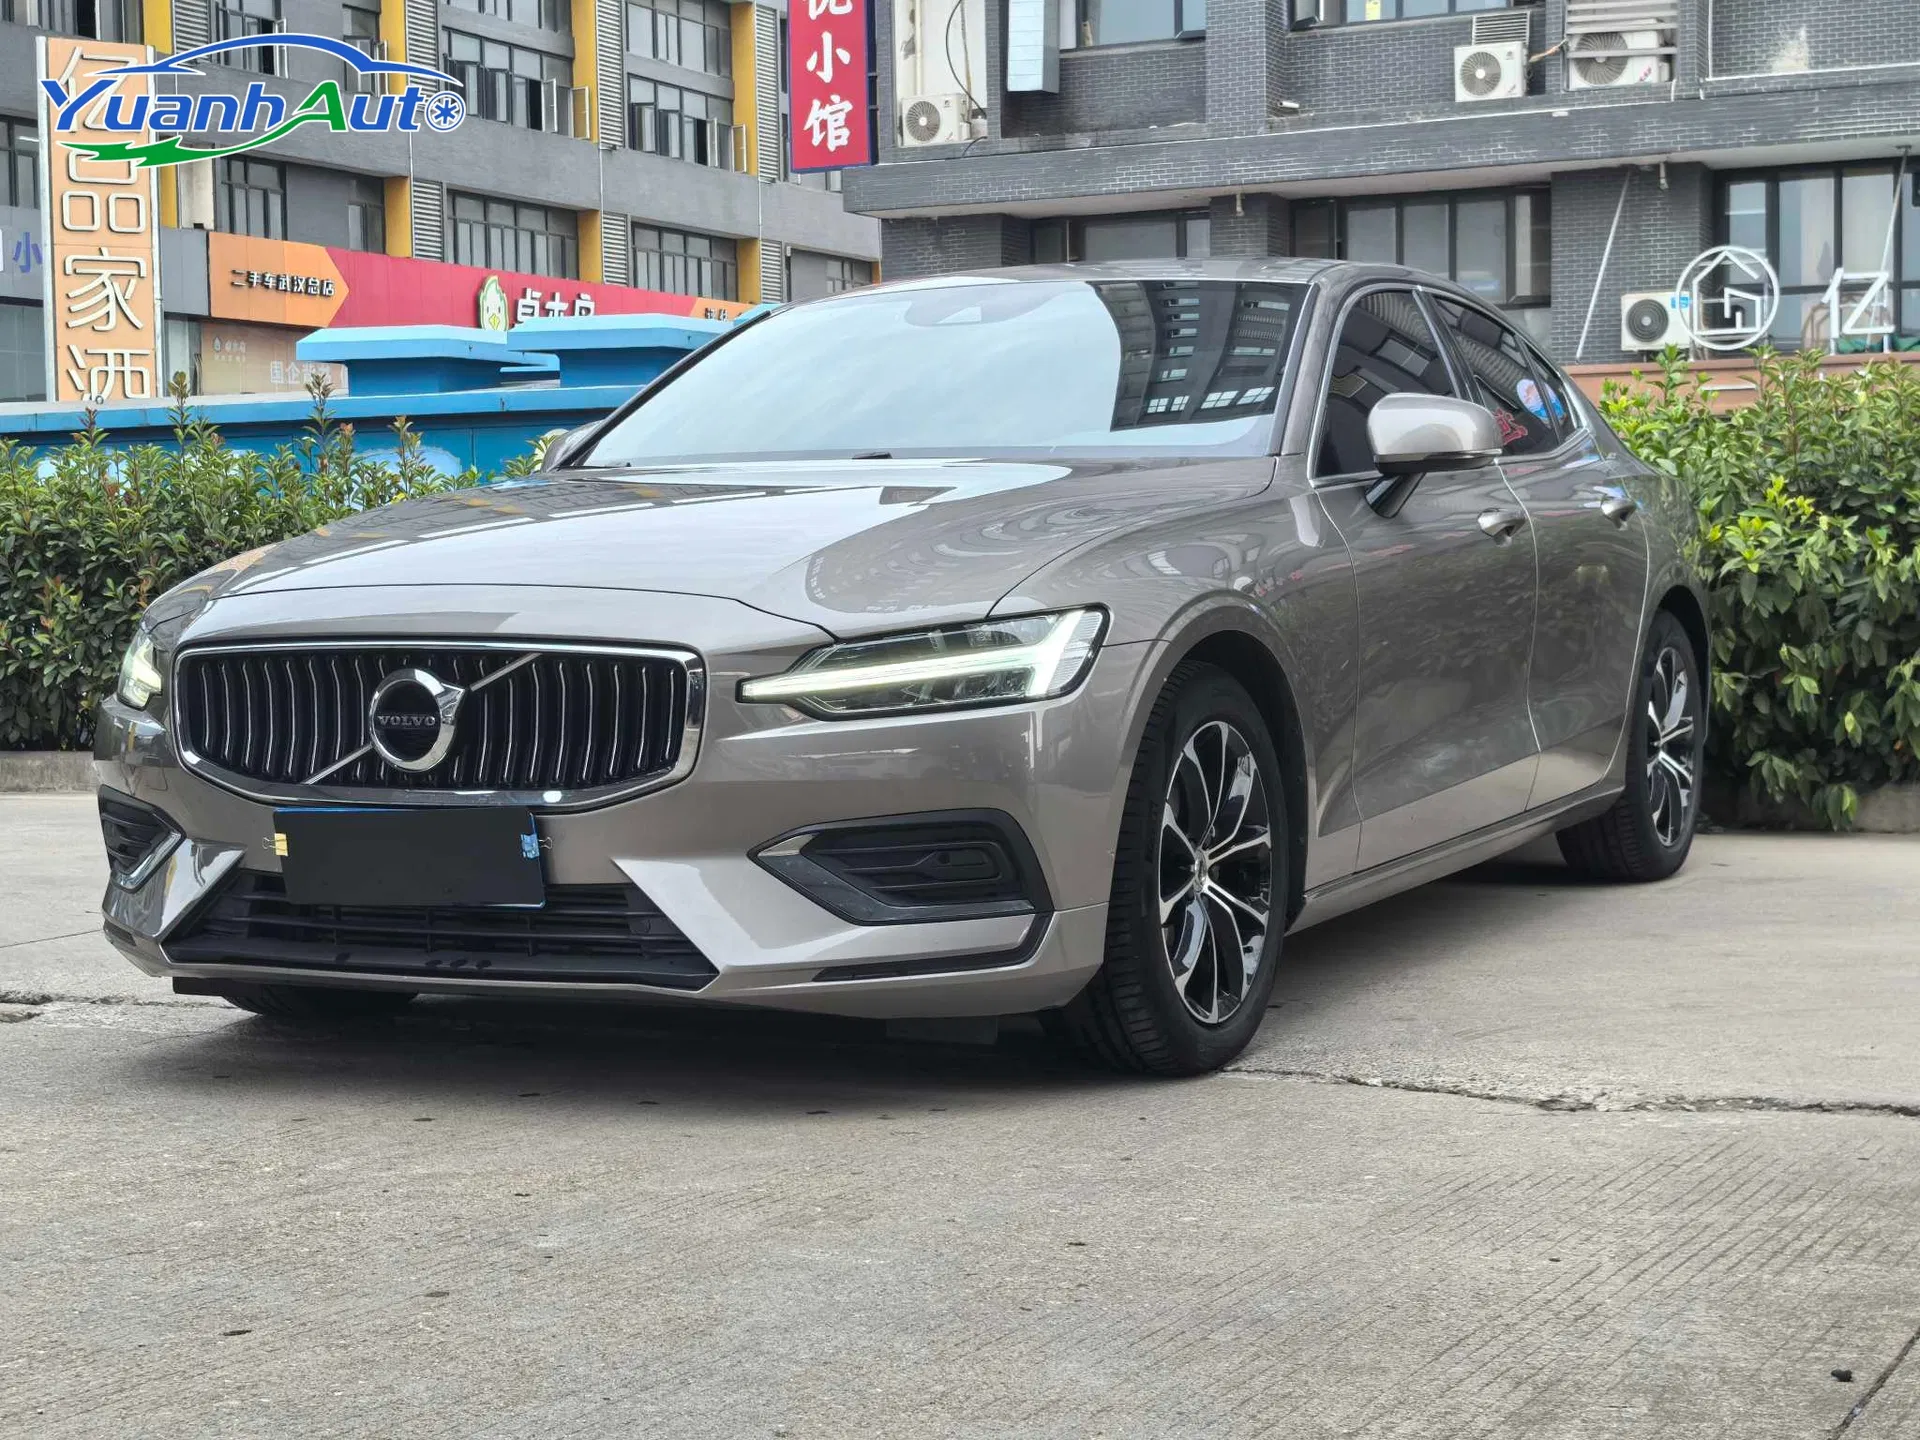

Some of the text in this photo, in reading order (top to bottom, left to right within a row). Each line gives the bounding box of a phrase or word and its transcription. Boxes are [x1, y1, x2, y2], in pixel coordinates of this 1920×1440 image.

[231, 269, 335, 297] 二手车武汉总店
[377, 715, 436, 726] VOLVO
